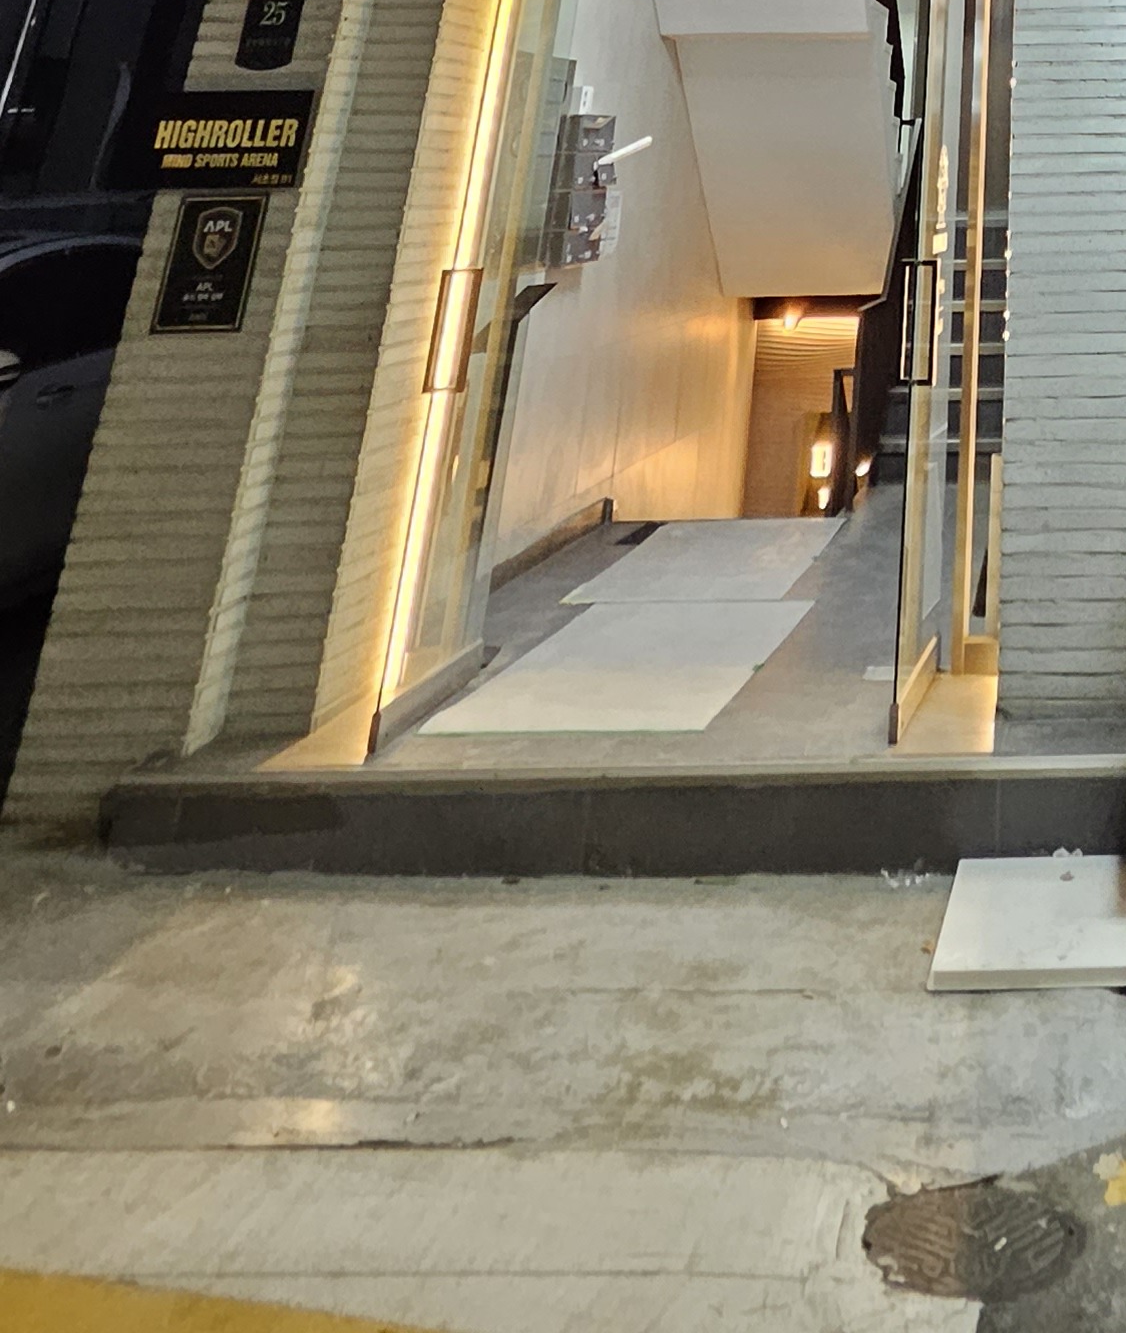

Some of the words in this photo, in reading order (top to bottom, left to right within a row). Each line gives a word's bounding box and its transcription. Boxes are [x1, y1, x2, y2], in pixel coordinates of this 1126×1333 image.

[259, 0, 289, 26] 25
[153, 118, 299, 149] HIGHROLLER
[194, 153, 239, 168] SPORTS
[203, 220, 233, 233] APL
